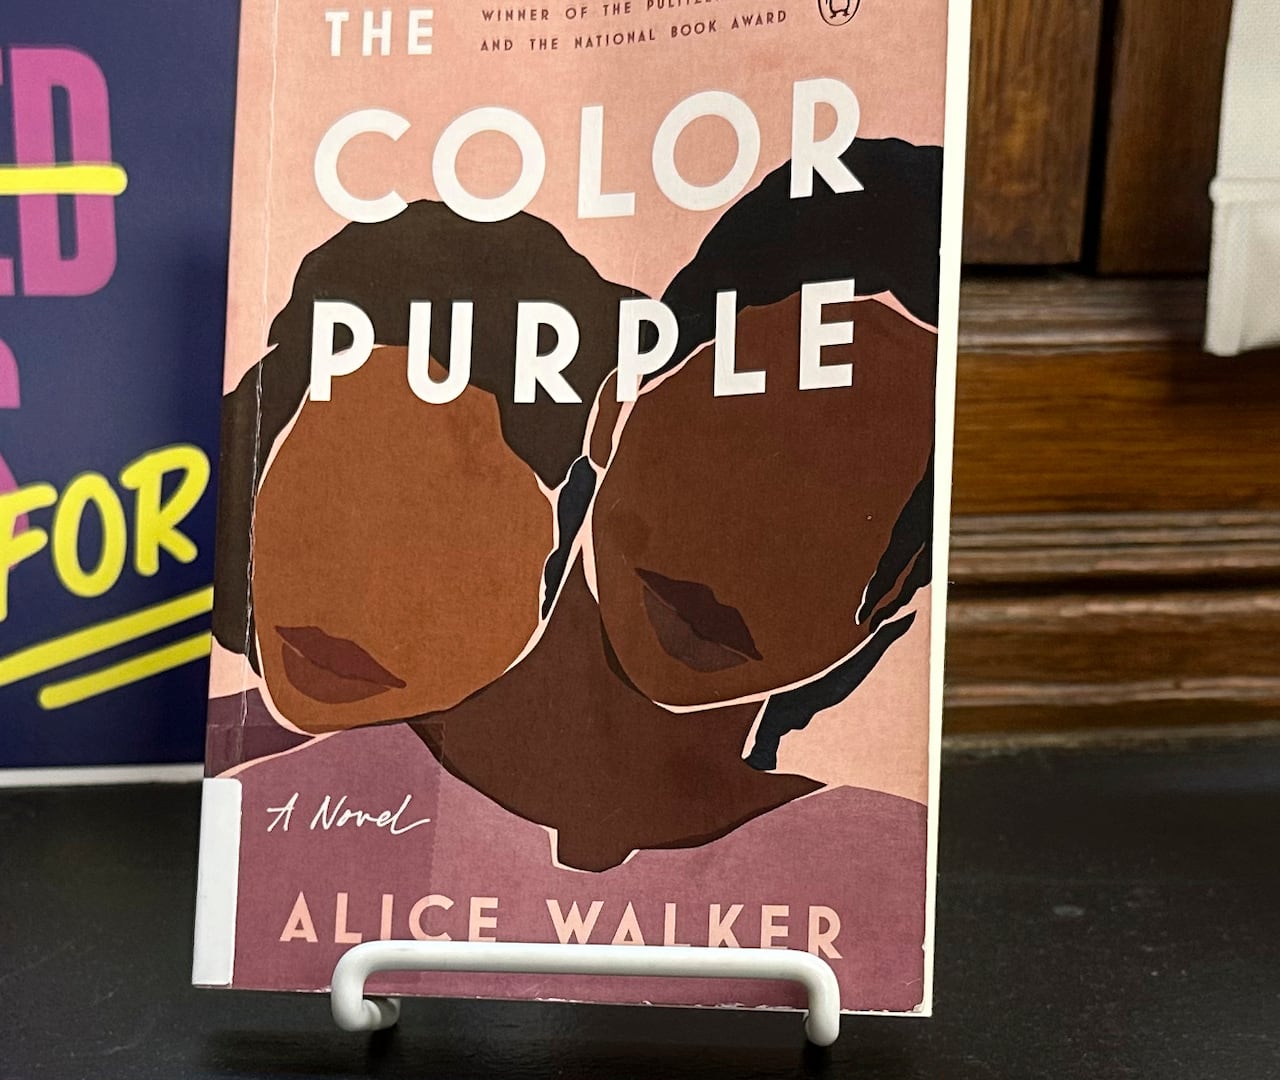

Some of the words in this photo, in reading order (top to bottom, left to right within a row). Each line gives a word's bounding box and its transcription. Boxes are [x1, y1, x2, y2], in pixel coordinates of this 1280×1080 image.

[323, 9, 433, 58] THE
[480, 39, 514, 52] AND
[529, 37, 559, 51] THE
[574, 28, 656, 49] NATIONAL
[671, 19, 717, 39] BOOK
[730, 9, 787, 31] AWARD
[481, 8, 550, 22] WINNER
[565, 6, 588, 20] OF
[602, 1, 632, 16] THE
[313, 76, 865, 224] COLOR
[309, 278, 856, 406] PURPLE
[266, 791, 300, 832] A
[309, 793, 432, 835] Novel
[278, 890, 500, 943] ALICE
[544, 898, 844, 960] WALKER
